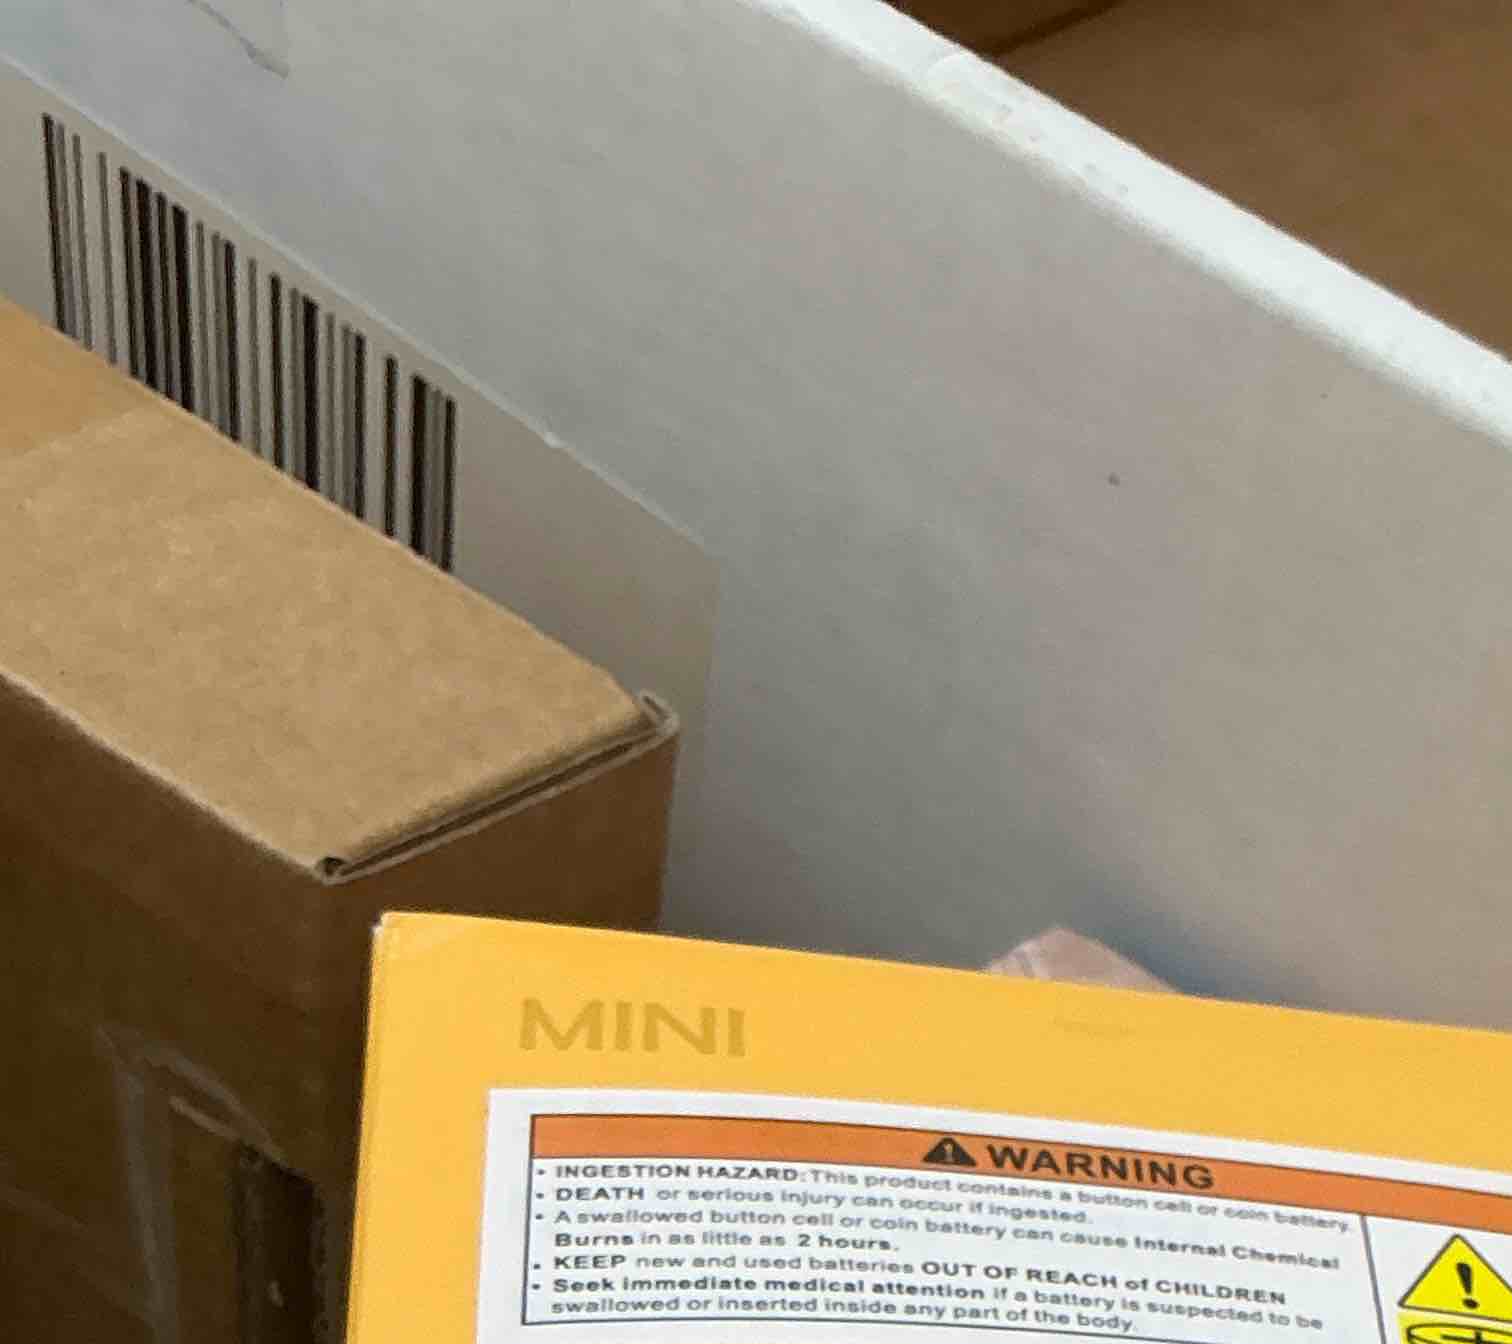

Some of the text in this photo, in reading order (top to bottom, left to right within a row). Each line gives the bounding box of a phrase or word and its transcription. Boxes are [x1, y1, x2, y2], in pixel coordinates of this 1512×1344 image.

[517, 996, 746, 1058] MINI
[554, 1164, 1149, 1210] INGESTION product contains button
[986, 1143, 1214, 1190] WARNING
[554, 1186, 963, 1214] DEATH serious injury can occur
[554, 1232, 900, 1252] Burns little hours.
[576, 1209, 1341, 1270] swallowed button cell coin battery cause Internal Chemical
[552, 1276, 1264, 1324] Seek immediate medical attention battery suspected
[553, 1254, 1287, 1306] KEEP new and used batteries OUT OF REACH CHILDREN
[550, 1296, 1137, 1334] swallowed inserted inside any part body.
